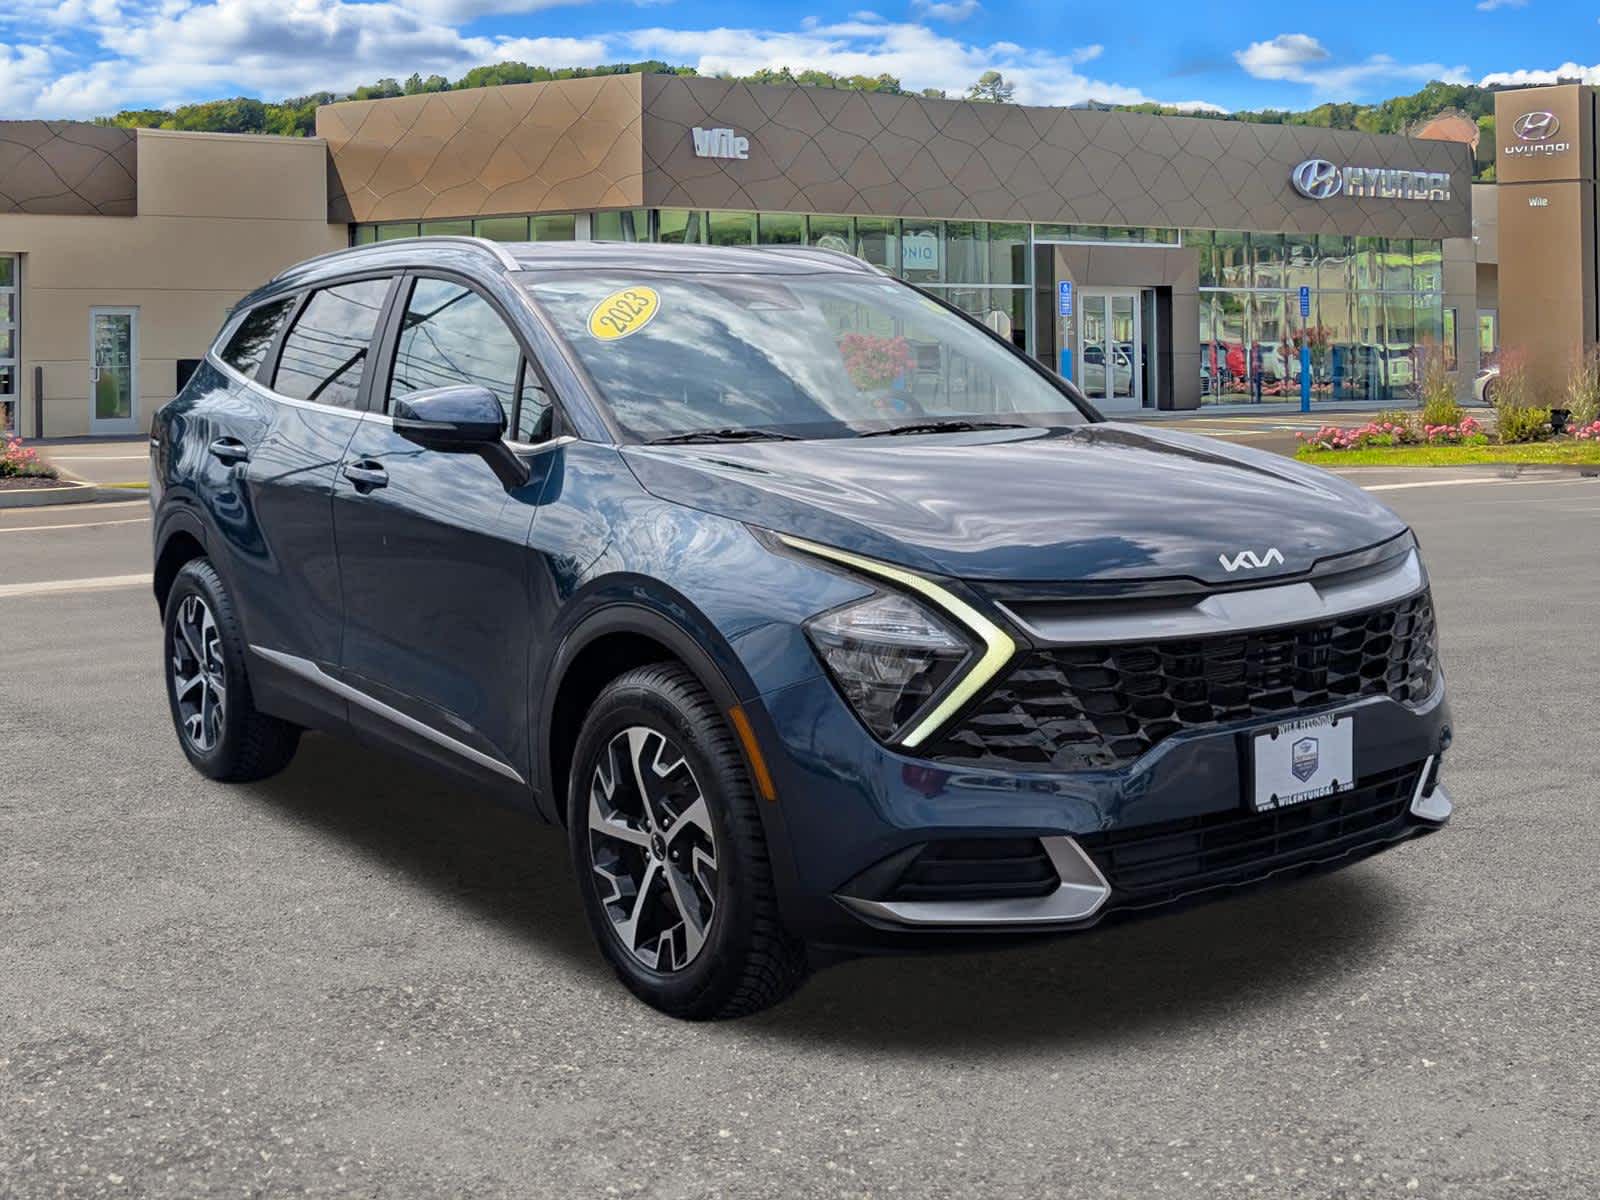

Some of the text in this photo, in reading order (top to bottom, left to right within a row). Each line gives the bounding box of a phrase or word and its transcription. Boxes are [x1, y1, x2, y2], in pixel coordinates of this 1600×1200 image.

[692, 127, 749, 160] Wile
[1342, 167, 1451, 201] HYUNDAI
[1528, 196, 1549, 207] Wile
[600, 292, 649, 333] 2023
